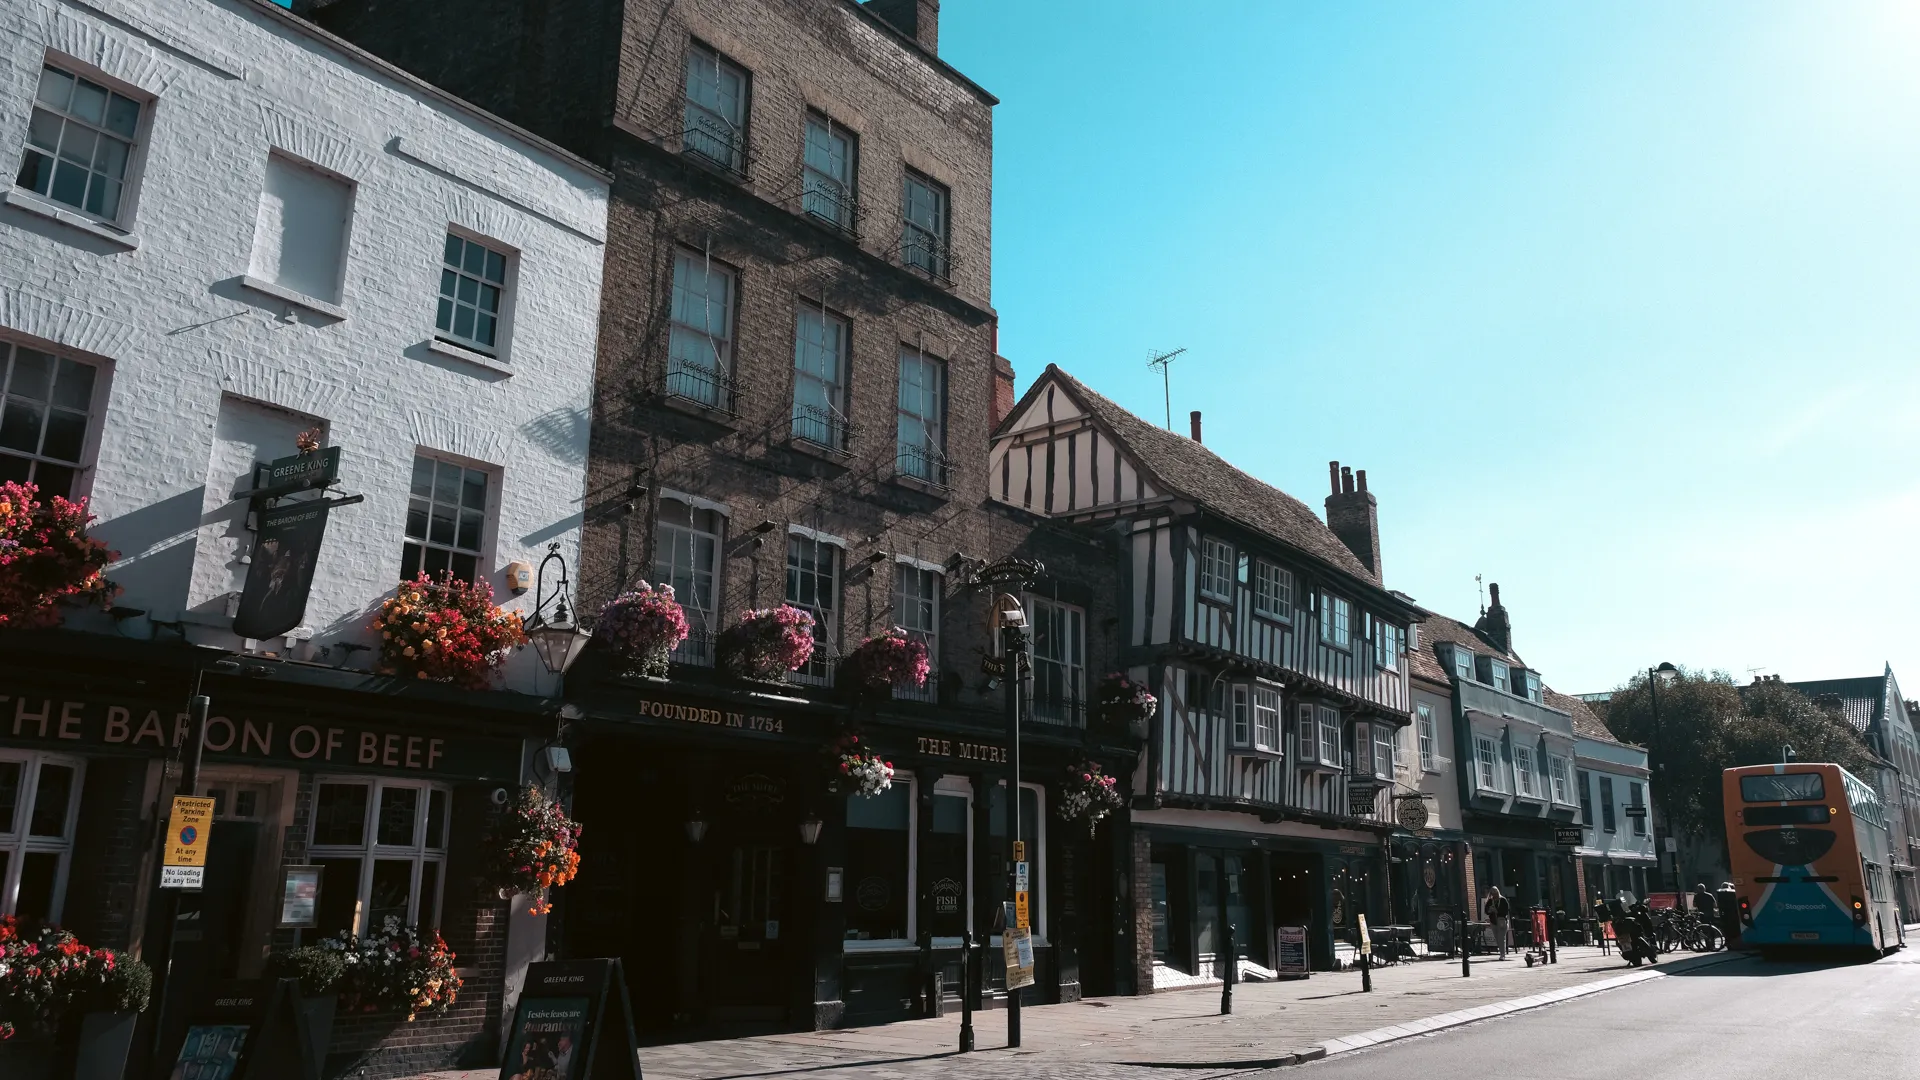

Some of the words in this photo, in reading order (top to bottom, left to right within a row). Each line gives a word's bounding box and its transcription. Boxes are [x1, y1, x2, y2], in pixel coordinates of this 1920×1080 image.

[273, 463, 305, 477] GREENE
[307, 458, 329, 470] KING
[266, 520, 277, 528] THE
[277, 516, 298, 526] BARON
[298, 513, 306, 522] OF
[305, 511, 319, 520] BEEF
[639, 700, 721, 725] FOUNDED
[725, 712, 744, 728] IN
[749, 715, 784, 733] 1754
[0, 695, 85, 741] HE
[104, 705, 274, 755] BARON
[289, 725, 345, 761] OF
[358, 731, 444, 769] BEEF
[917, 736, 951, 757] THE
[177, 800, 211, 808] Restricted
[1351, 804, 1374, 814] ARTS
[180, 808, 205, 816] Parking
[177, 869, 201, 877] loading
[936, 896, 957, 905] FISH
[1785, 903, 1826, 911] Stagecoach
[214, 998, 238, 1007] GREENE
[237, 997, 253, 1006] KING
[527, 1010, 550, 1019] Festive
[550, 1009, 569, 1018] feasts
[569, 1010, 581, 1018] are
